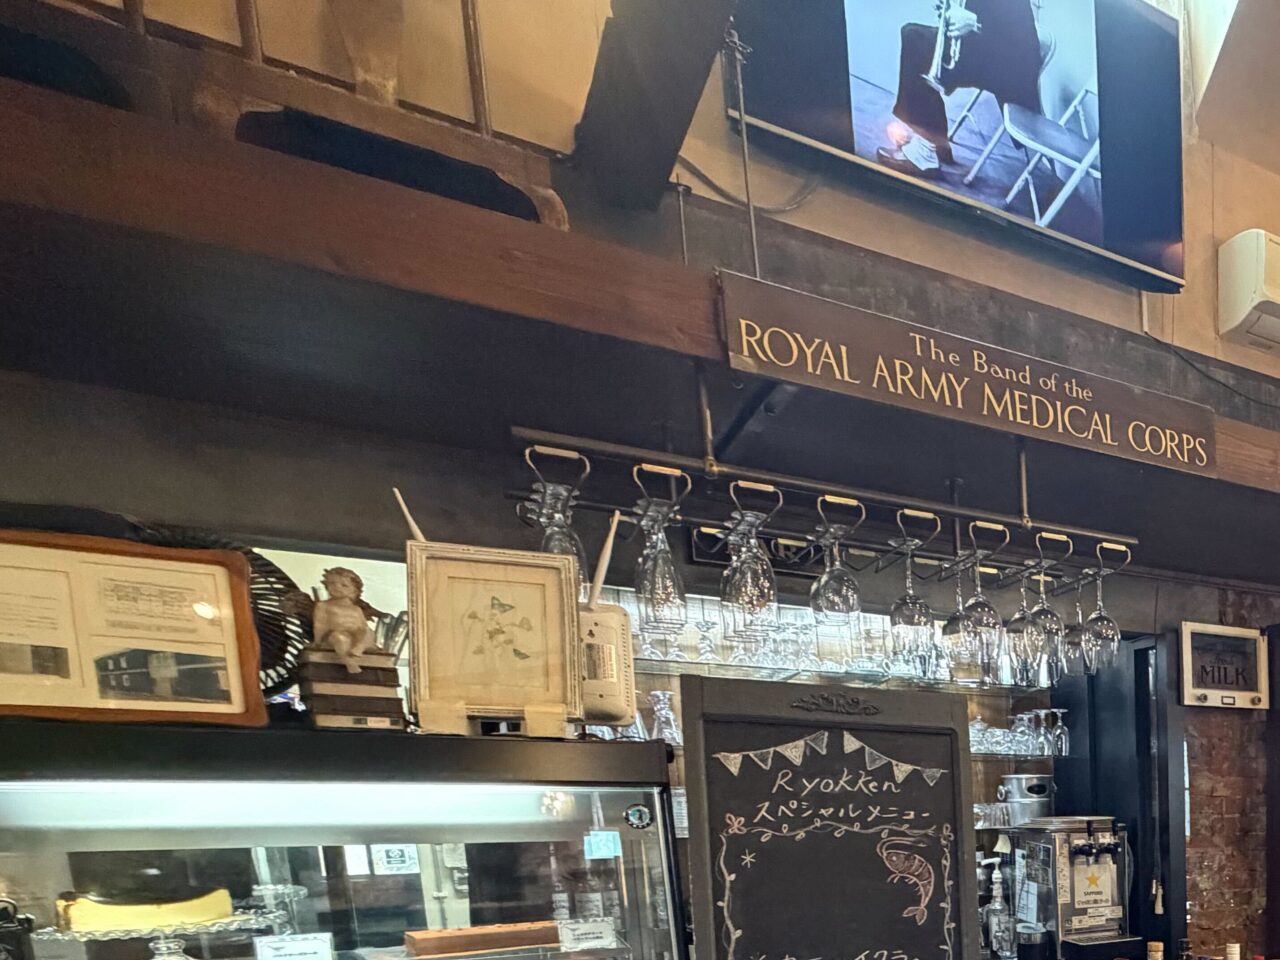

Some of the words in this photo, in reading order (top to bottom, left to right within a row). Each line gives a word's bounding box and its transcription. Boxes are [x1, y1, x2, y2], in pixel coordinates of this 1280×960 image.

[909, 333, 960, 368] The
[972, 350, 1031, 386] Band
[1039, 371, 1061, 393] of
[1064, 378, 1093, 402] the
[738, 318, 861, 384] ROYAL
[872, 354, 970, 409] ARMY
[982, 383, 1119, 447] MEDICAL
[1128, 420, 1208, 467] CORPS
[1200, 665, 1248, 686] MILK
[752, 801, 931, 823] スペシャルメニュー
